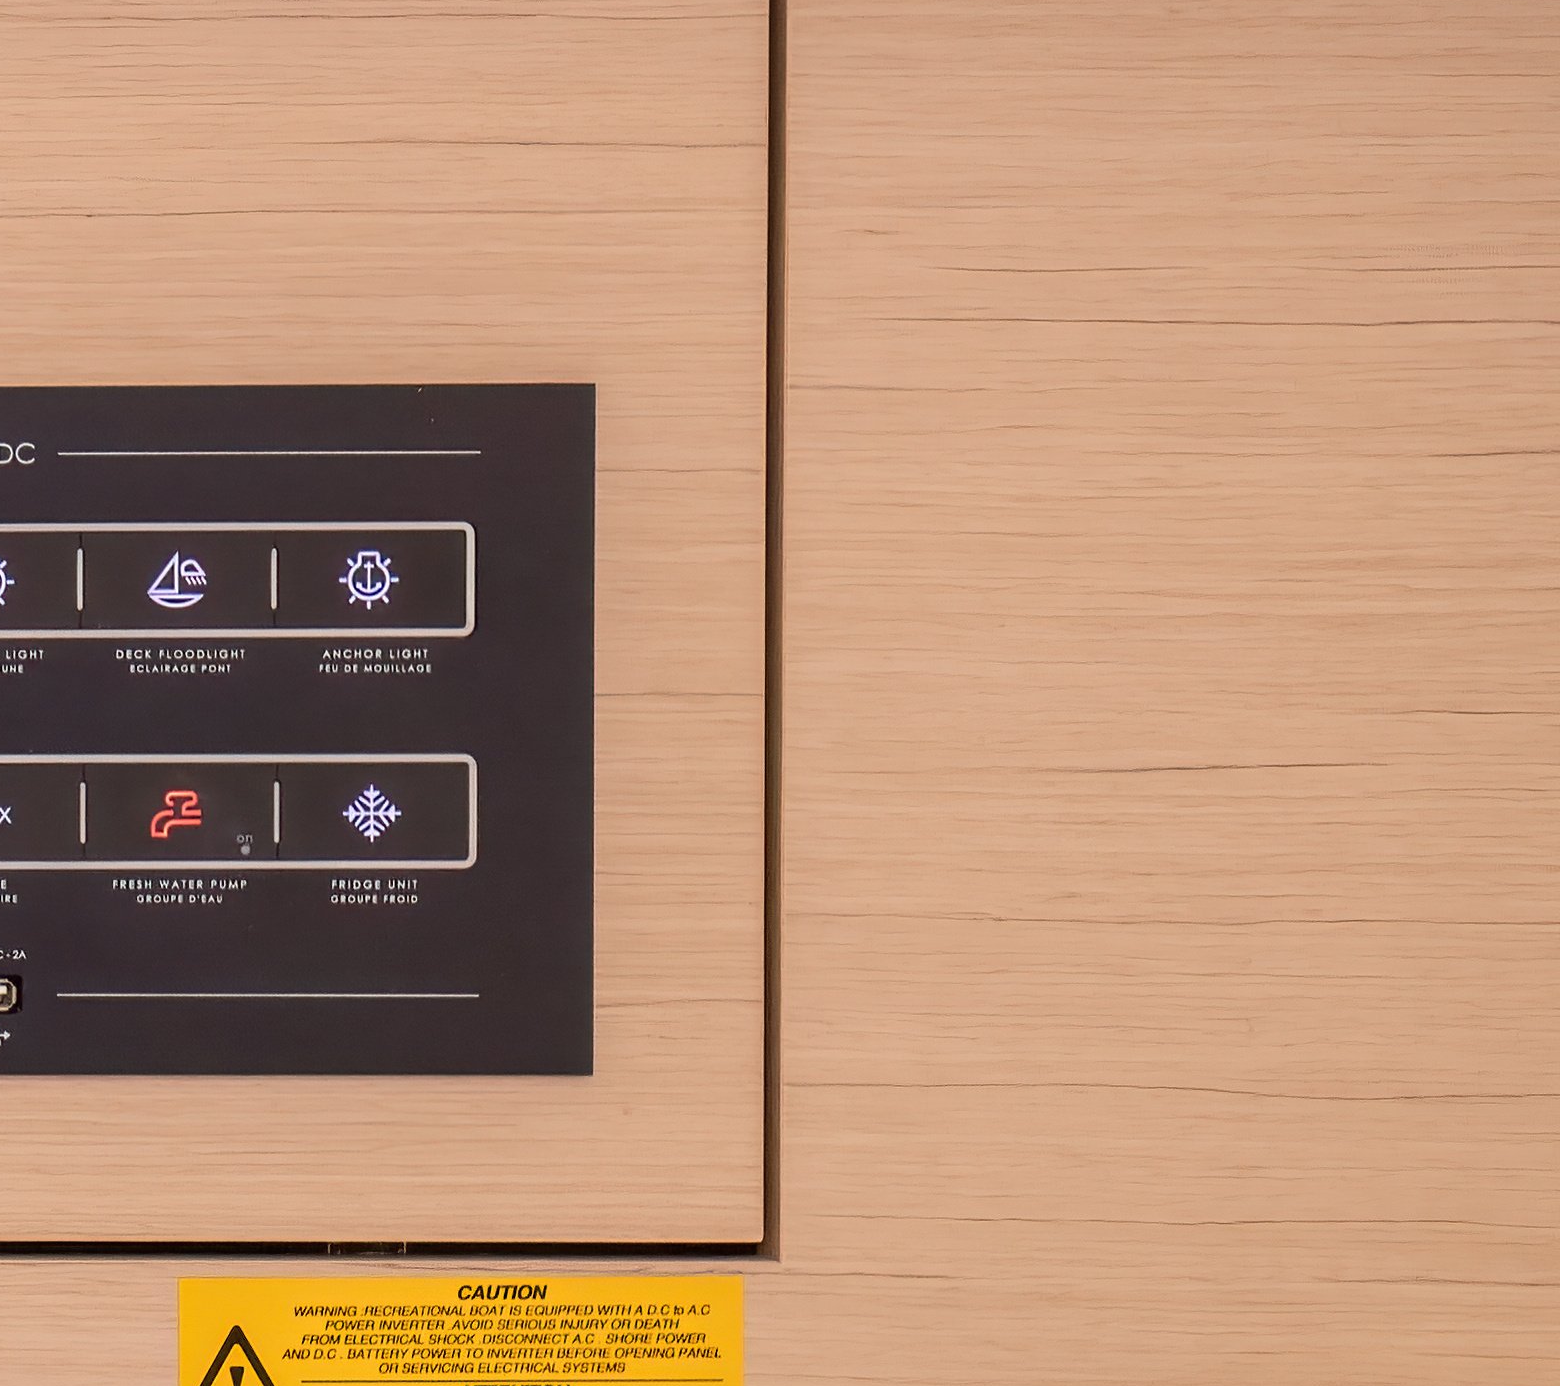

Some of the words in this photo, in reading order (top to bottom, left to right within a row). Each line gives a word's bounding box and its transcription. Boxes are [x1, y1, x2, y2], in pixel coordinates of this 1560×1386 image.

[6, 650, 43, 659] LIGHT
[116, 650, 151, 659] DECK
[159, 649, 244, 659] FLOODLIGHT
[323, 649, 381, 659] ANCHOR
[390, 649, 427, 659] LIGHT
[130, 664, 195, 673] ECLAIRAGE
[202, 665, 230, 673] PONT
[320, 664, 338, 672] FEU
[344, 664, 357, 673] DE
[364, 664, 431, 673] MOUILLAGE
[237, 835, 253, 843] on
[113, 880, 151, 889] FRESH
[160, 880, 202, 889] WATER
[211, 880, 246, 889] PUMP
[332, 880, 380, 890] FRIDGE
[389, 880, 417, 889] UNIT
[137, 894, 183, 903] GROUPE
[189, 894, 222, 903] D'EAU
[331, 895, 377, 903] GROUPE
[384, 895, 417, 903] FROID
[13, 950, 26, 959] 2A
[458, 1285, 547, 1300] CAUTION
[294, 1306, 357, 1317] WARNING
[470, 1305, 505, 1316] BOAT
[509, 1305, 522, 1316] IS
[526, 1305, 593, 1316] EQUIPPED
[598, 1304, 631, 1316] WITH
[634, 1305, 642, 1315] A
[674, 1305, 684, 1315] to
[325, 1320, 374, 1331] POWER
[379, 1320, 444, 1330] INVERTER
[497, 1319, 555, 1330] SERIOUS
[560, 1319, 607, 1330] INJURY
[611, 1318, 630, 1330] OR
[634, 1318, 679, 1330] DEATH
[302, 1334, 340, 1345] FROM
[344, 1334, 423, 1345] ELECTRICAL
[429, 1333, 475, 1345] SHOCK
[606, 1333, 652, 1344] SHORE
[656, 1333, 705, 1344] POWER
[282, 1349, 310, 1360] AND
[348, 1348, 408, 1359] BATTERY
[412, 1348, 461, 1359] POWER
[466, 1348, 483, 1358] TO
[487, 1348, 553, 1359] INVERTER
[557, 1347, 610, 1359] BEFORE
[615, 1347, 675, 1359] OPENING
[379, 1363, 399, 1374] OR
[402, 1362, 474, 1374] SERVICING
[478, 1362, 559, 1374] ELECTRICAL
[563, 1362, 625, 1373] SYSTEMS
